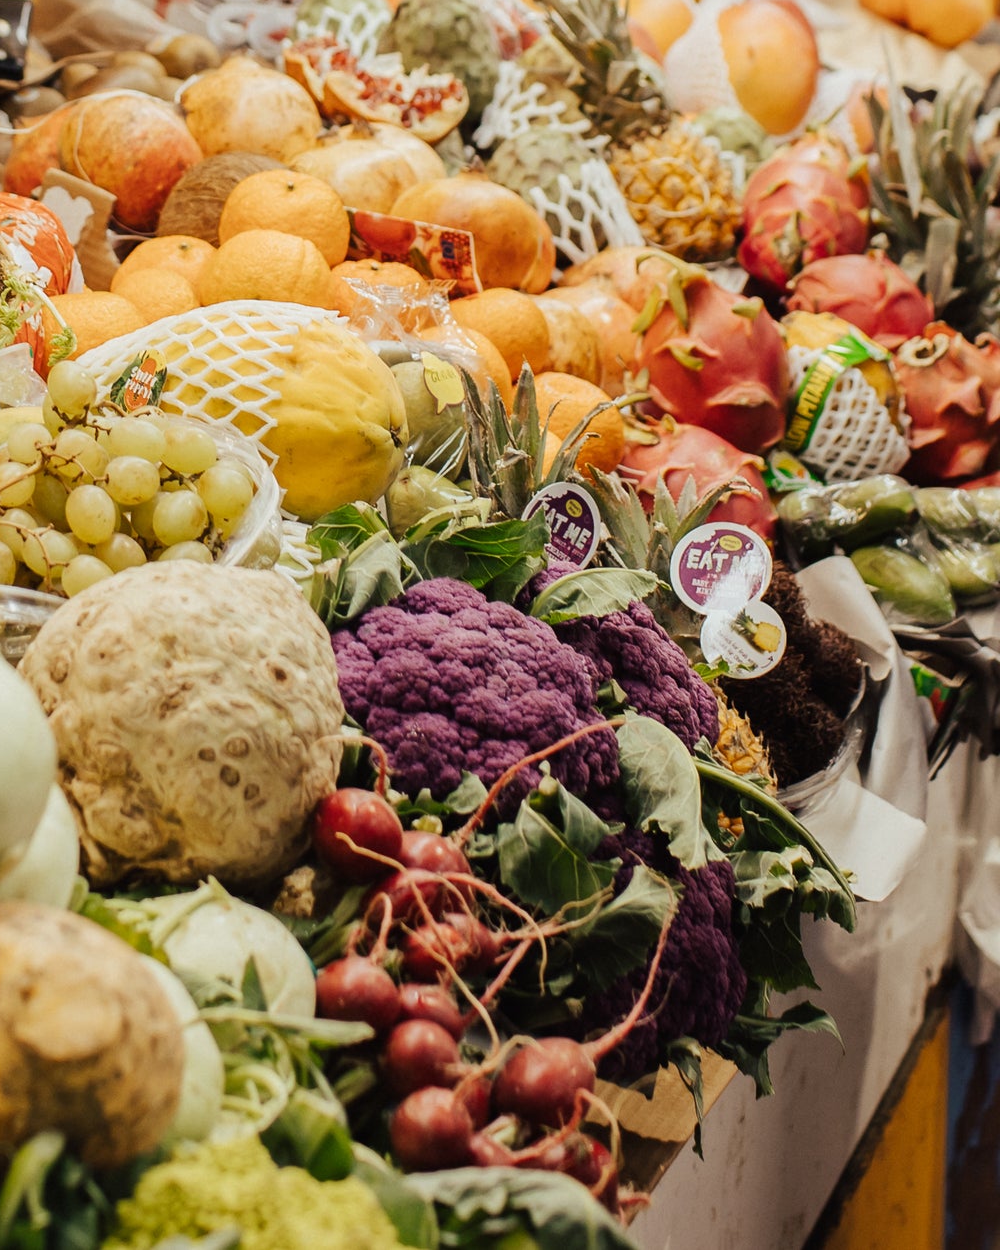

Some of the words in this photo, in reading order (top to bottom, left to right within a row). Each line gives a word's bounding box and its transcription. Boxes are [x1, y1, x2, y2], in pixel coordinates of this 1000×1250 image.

[541, 500, 569, 534] AT
[562, 522, 592, 550] ME
[686, 547, 729, 573] EAT
